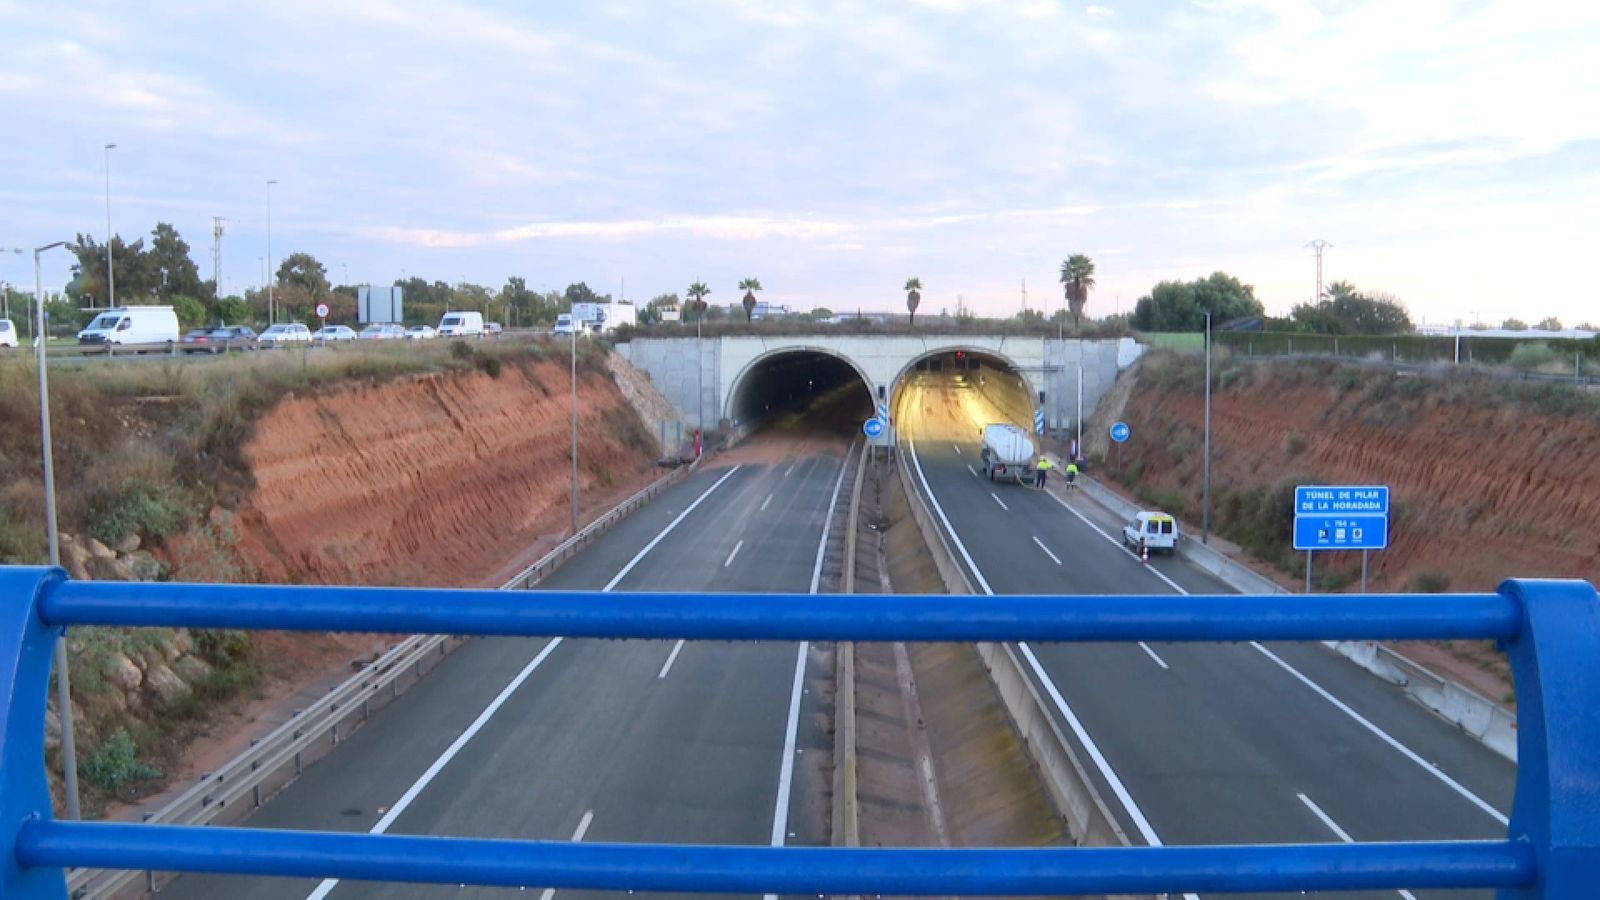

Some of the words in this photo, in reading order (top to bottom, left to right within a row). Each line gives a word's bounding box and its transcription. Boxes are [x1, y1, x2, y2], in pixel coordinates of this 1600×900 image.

[1306, 490, 1334, 499] TÚNEL
[1338, 491, 1350, 499] DE
[1354, 491, 1379, 499] PILAR
[1302, 501, 1314, 510] DE
[1318, 502, 1329, 510] LA
[1333, 501, 1380, 510] HORADADA
